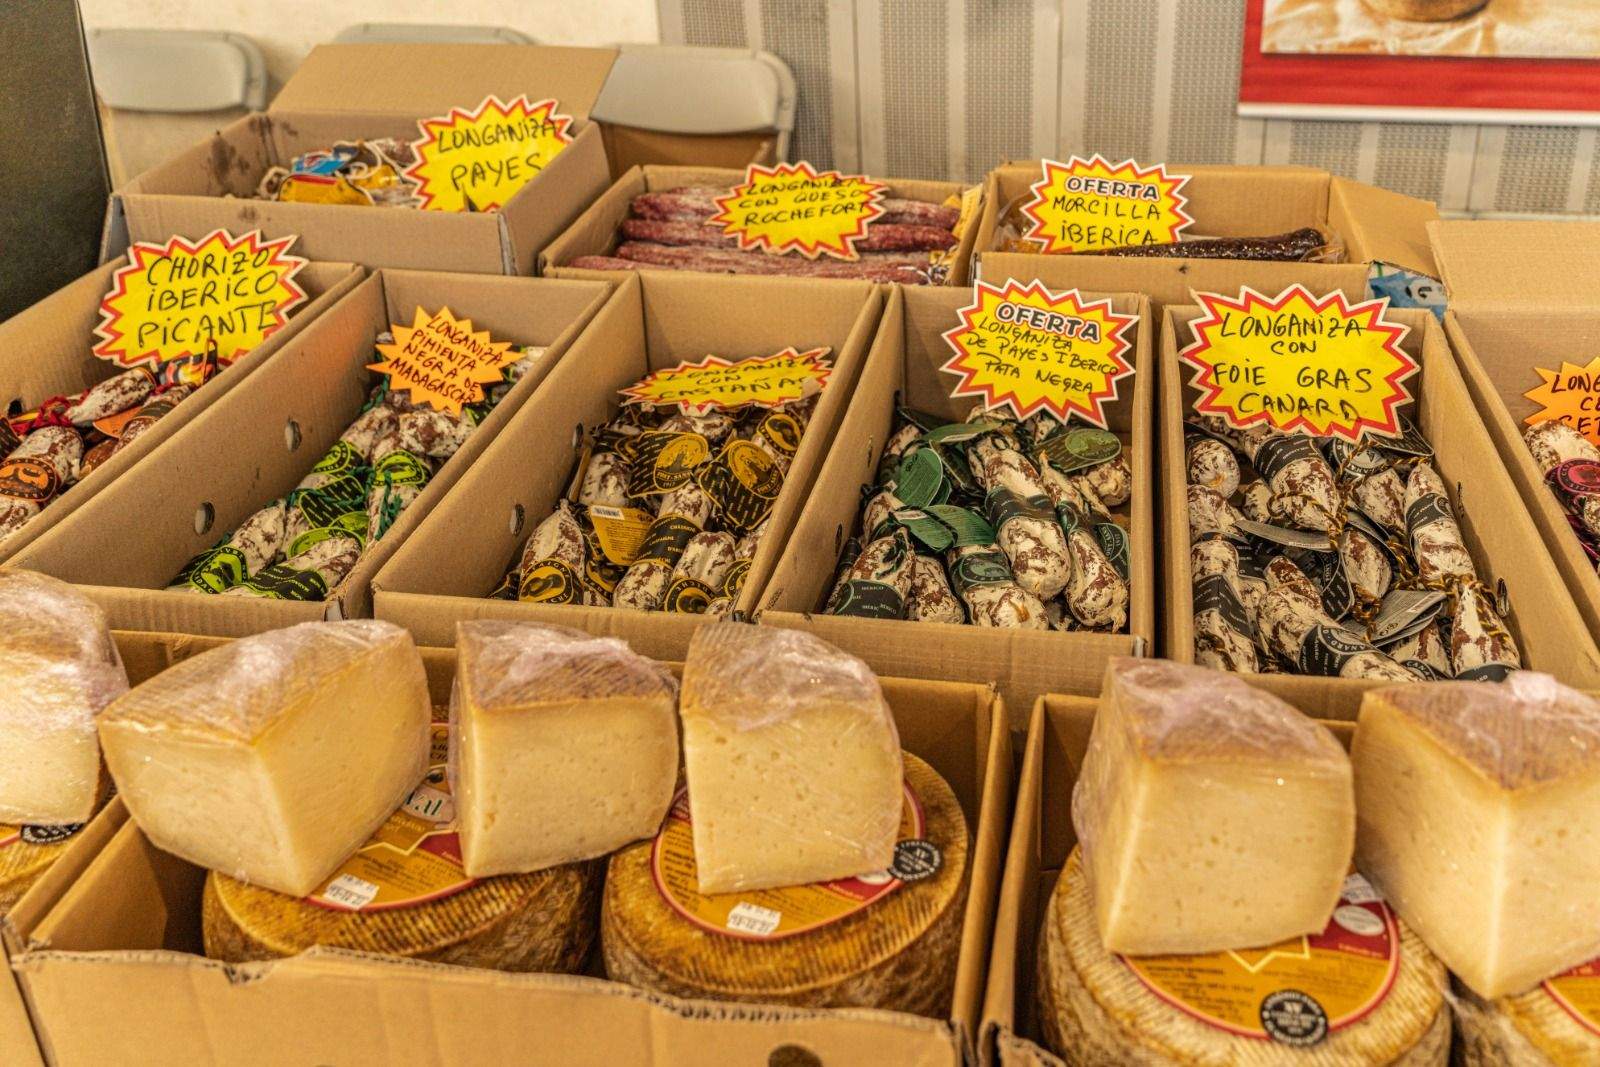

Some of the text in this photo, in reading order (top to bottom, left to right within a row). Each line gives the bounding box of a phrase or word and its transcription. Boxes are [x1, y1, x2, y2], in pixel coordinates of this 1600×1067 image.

[1066, 176, 1159, 200] OFERTA
[738, 197, 778, 209] CON
[744, 201, 866, 226] ROCHEFORT
[147, 247, 269, 287] CHORIZO
[997, 303, 1099, 341] OFERTA
[967, 331, 987, 348] DE
[1270, 340, 1317, 355] CON
[403, 343, 458, 379] NEGRA
[977, 352, 1093, 394] PATA NEGRA
[388, 357, 477, 405] MADAGASCAR
[1296, 366, 1373, 393] GRAS
[1238, 392, 1360, 423] CANARD
